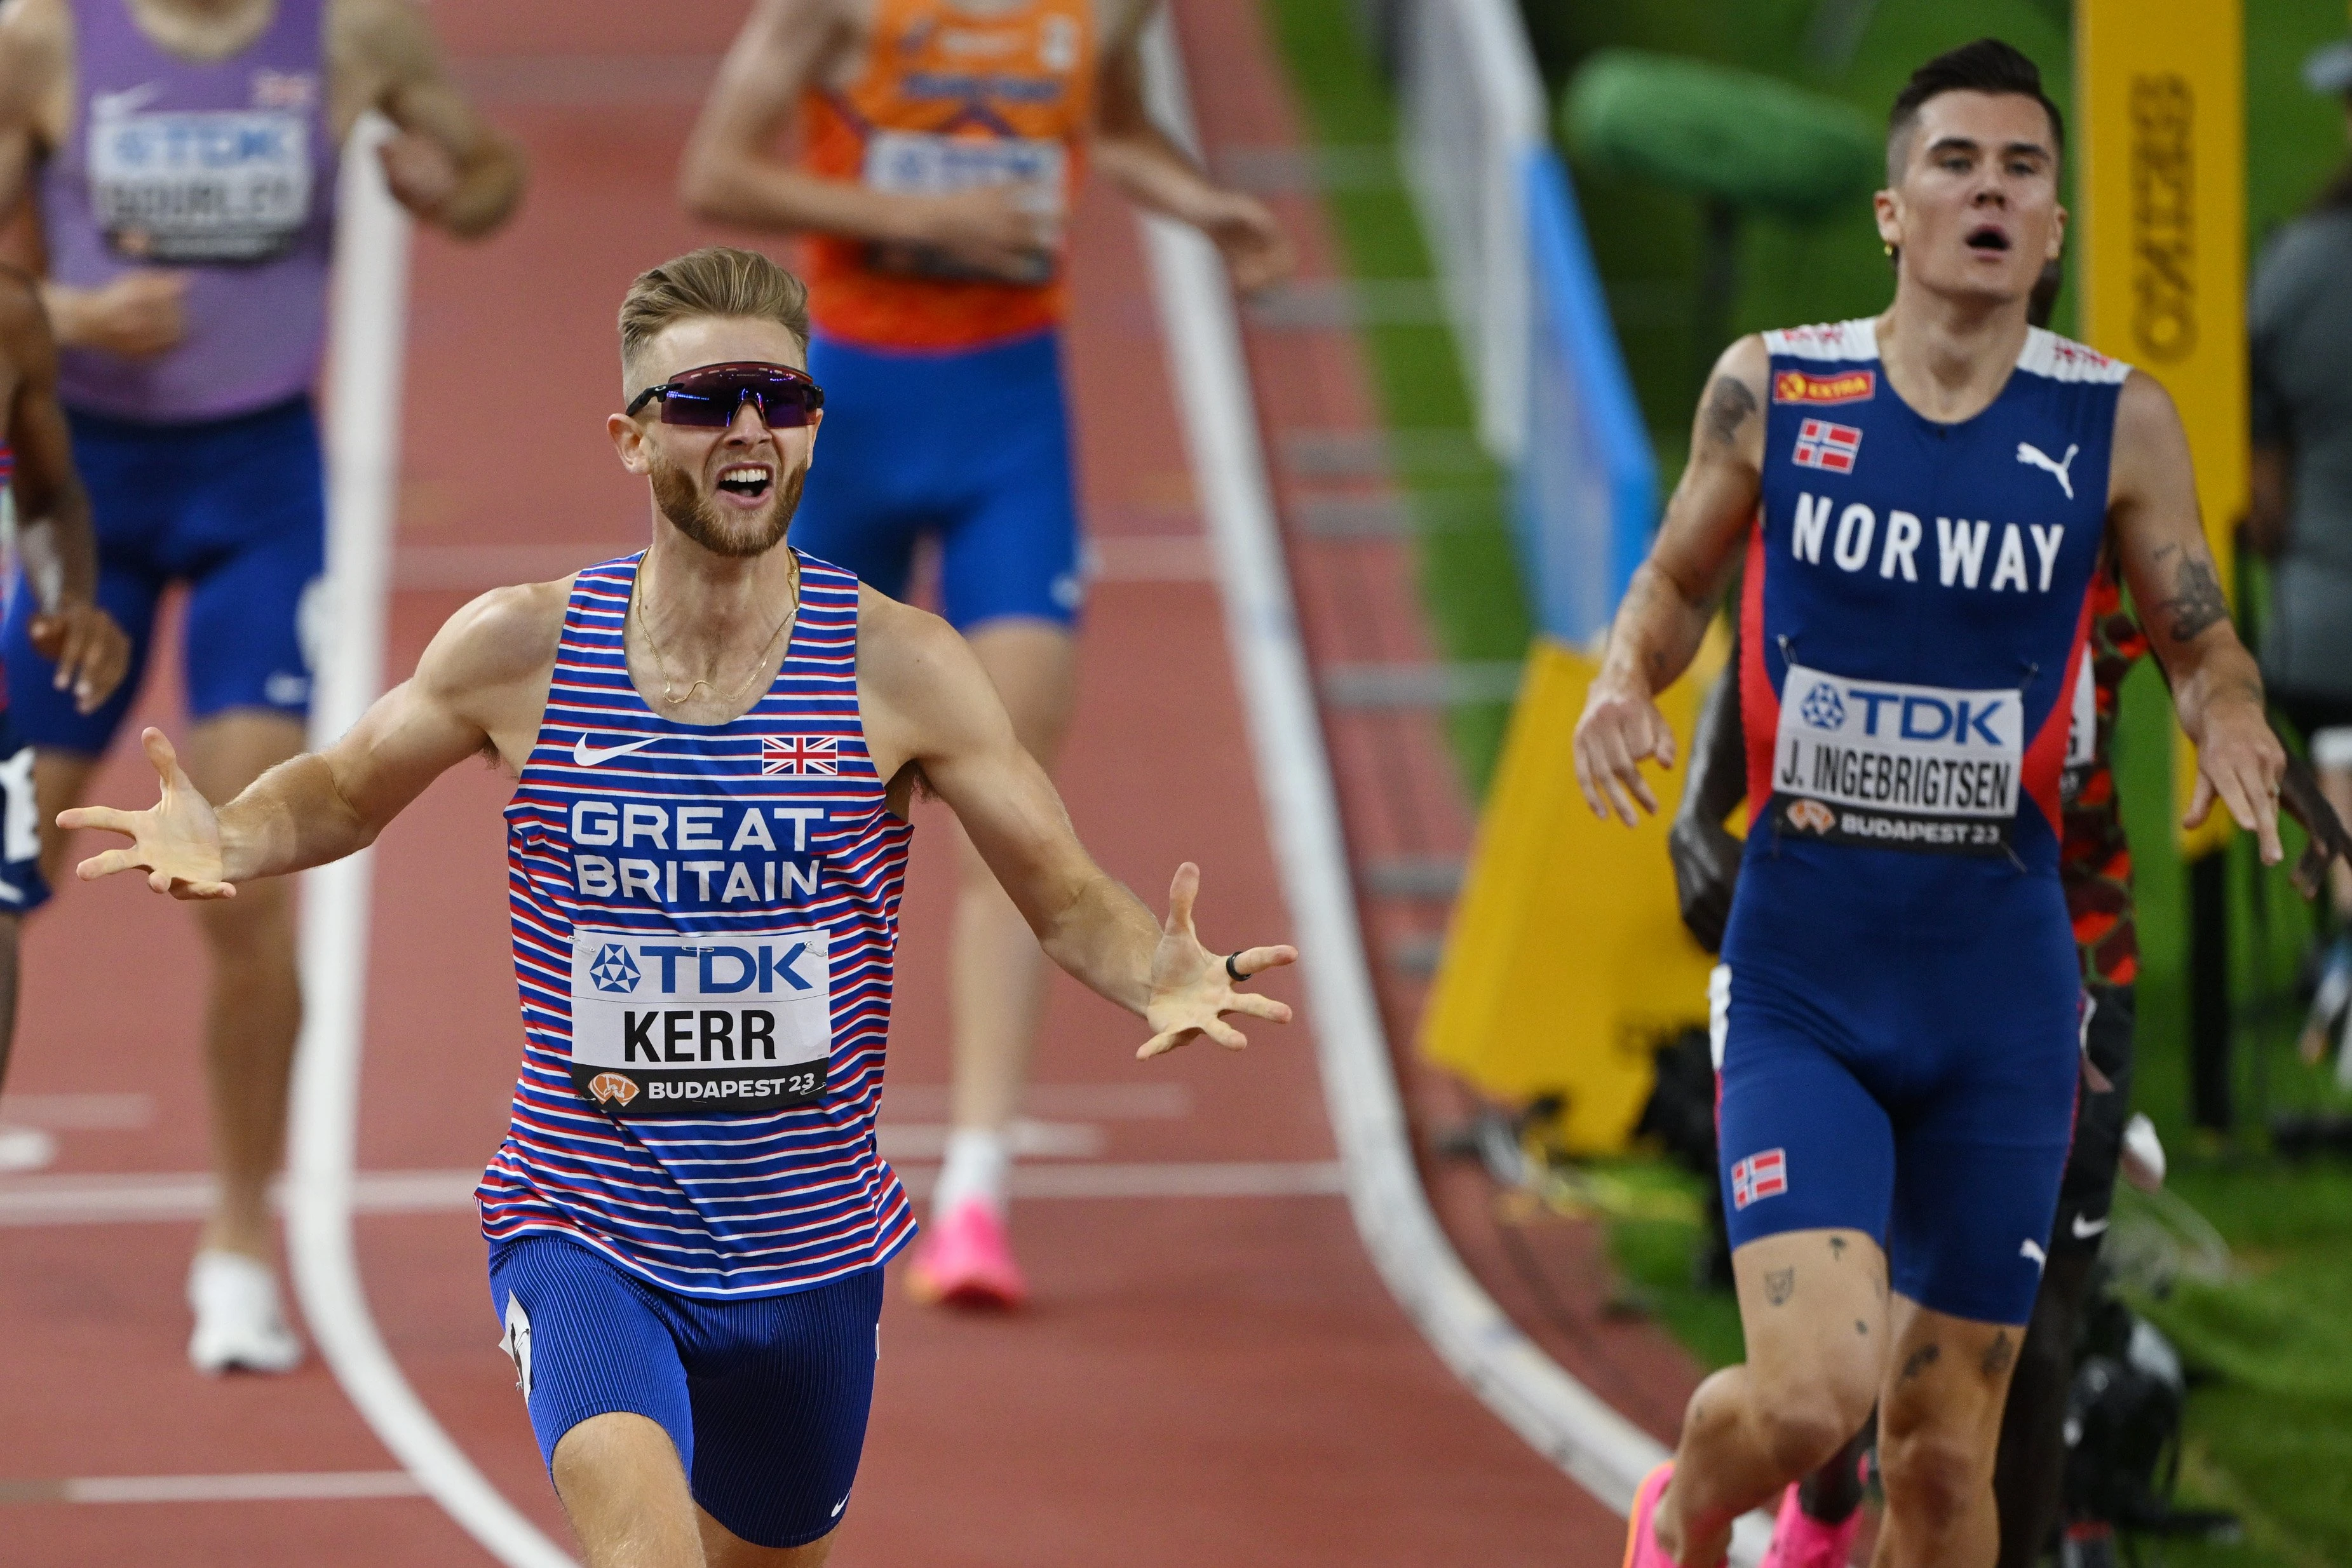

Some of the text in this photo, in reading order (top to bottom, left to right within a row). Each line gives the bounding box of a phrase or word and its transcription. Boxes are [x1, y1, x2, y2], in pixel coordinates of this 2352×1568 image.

[1808, 377, 1868, 398] EXTRA
[1792, 492, 2065, 593] NORWAY
[1846, 689, 2004, 746] TDK
[1781, 741, 1803, 788] J.
[1813, 748, 2011, 810] INGEBRIGTSEN
[571, 801, 824, 851] GREAT
[1842, 814, 2001, 845] BUDAPEST 23
[574, 855, 823, 903] BRITAIN
[639, 942, 813, 994] TDK
[625, 1009, 776, 1062] KERR
[649, 1072, 815, 1100] BUDAPEST 23
